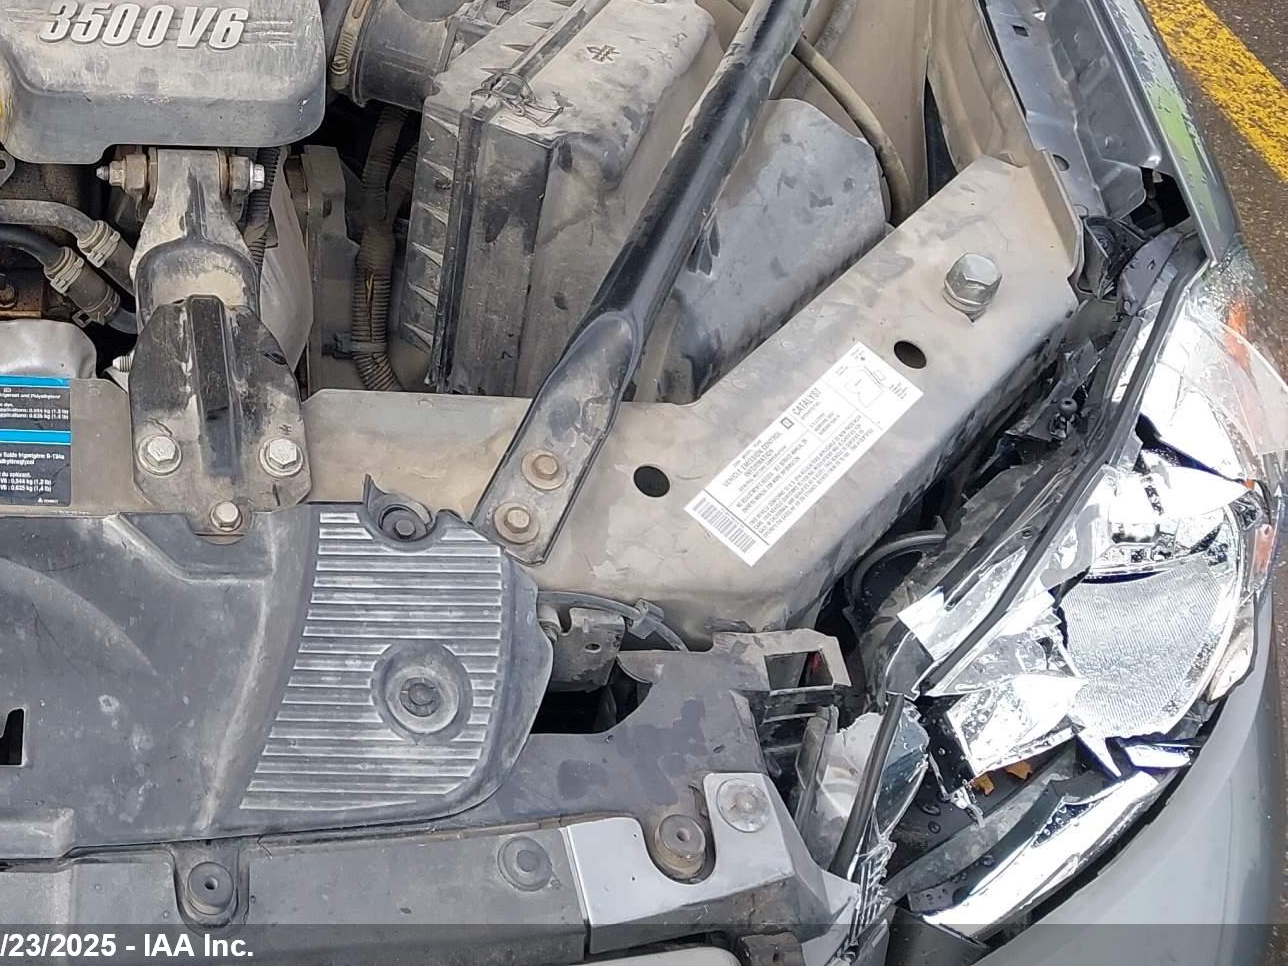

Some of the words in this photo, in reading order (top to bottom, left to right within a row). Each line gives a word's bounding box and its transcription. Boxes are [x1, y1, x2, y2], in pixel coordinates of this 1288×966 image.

[41, 0, 175, 47] 3500
[176, 5, 249, 49] V6
[791, 387, 823, 416] CATALYST
[721, 468, 743, 488] VEHICLE
[740, 448, 764, 471] EMISSION
[760, 430, 782, 451] CONTROL
[743, 448, 775, 478] INFORMATION
